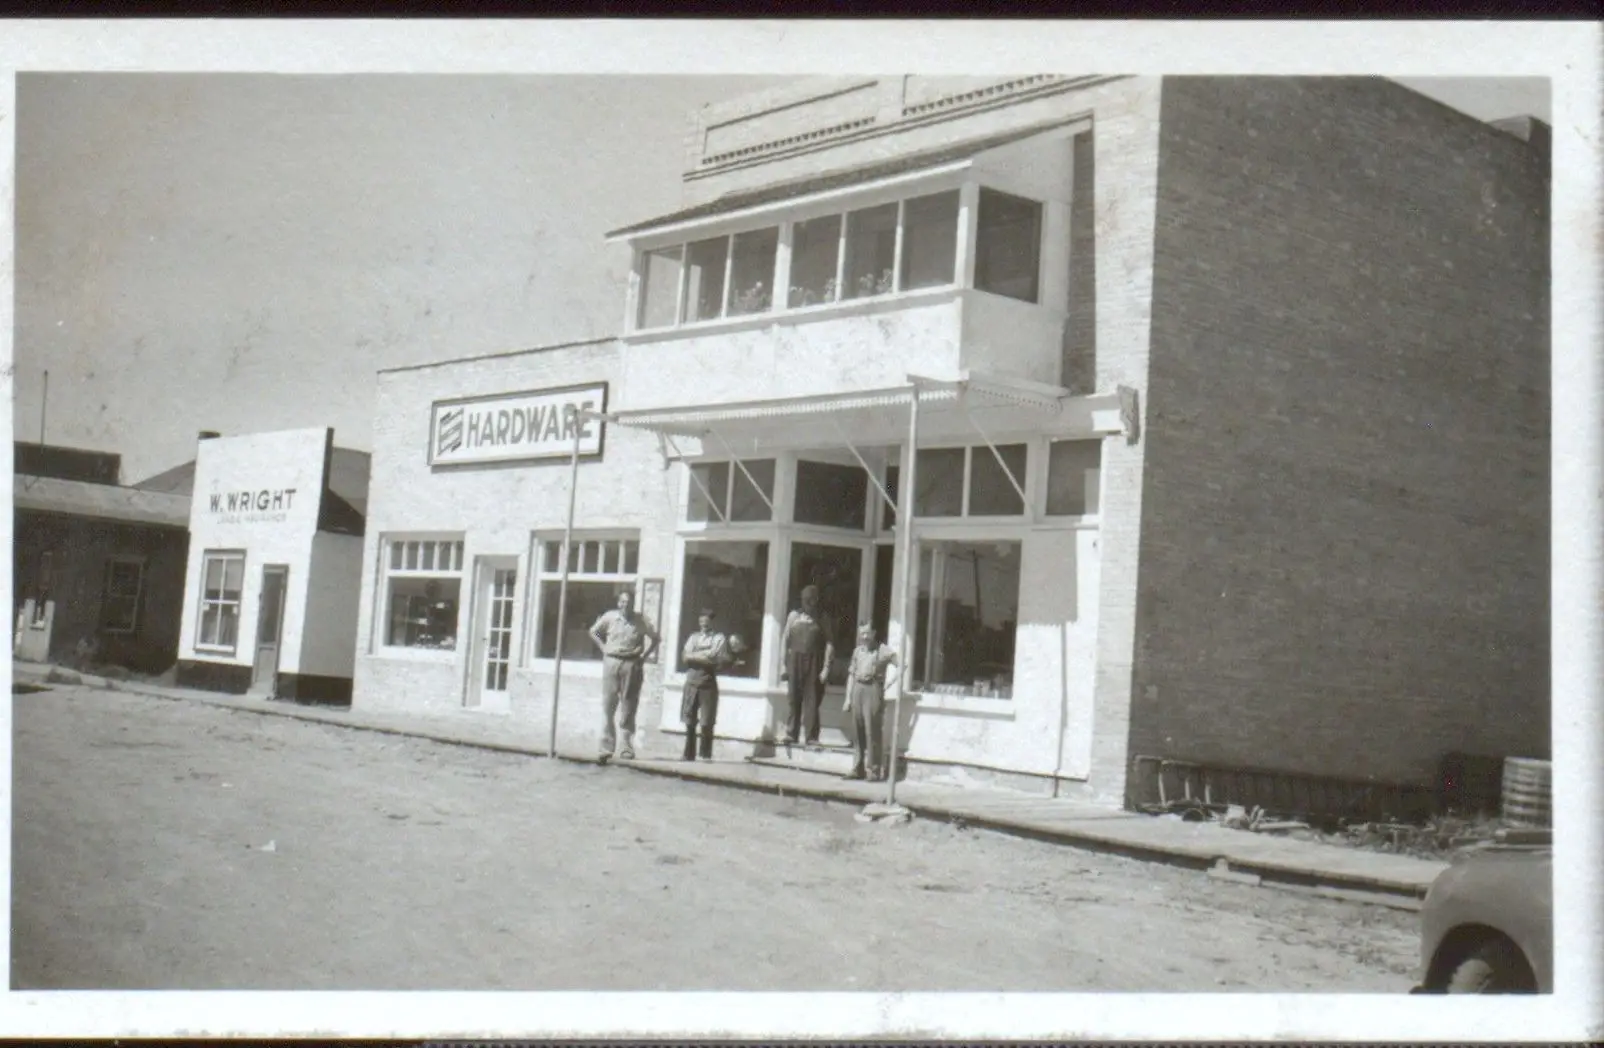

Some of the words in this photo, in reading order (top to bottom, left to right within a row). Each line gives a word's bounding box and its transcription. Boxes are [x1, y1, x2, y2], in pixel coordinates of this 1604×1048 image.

[466, 400, 594, 448] HARDWARE
[209, 493, 224, 513] W.
[227, 488, 297, 512] WRIGHT
